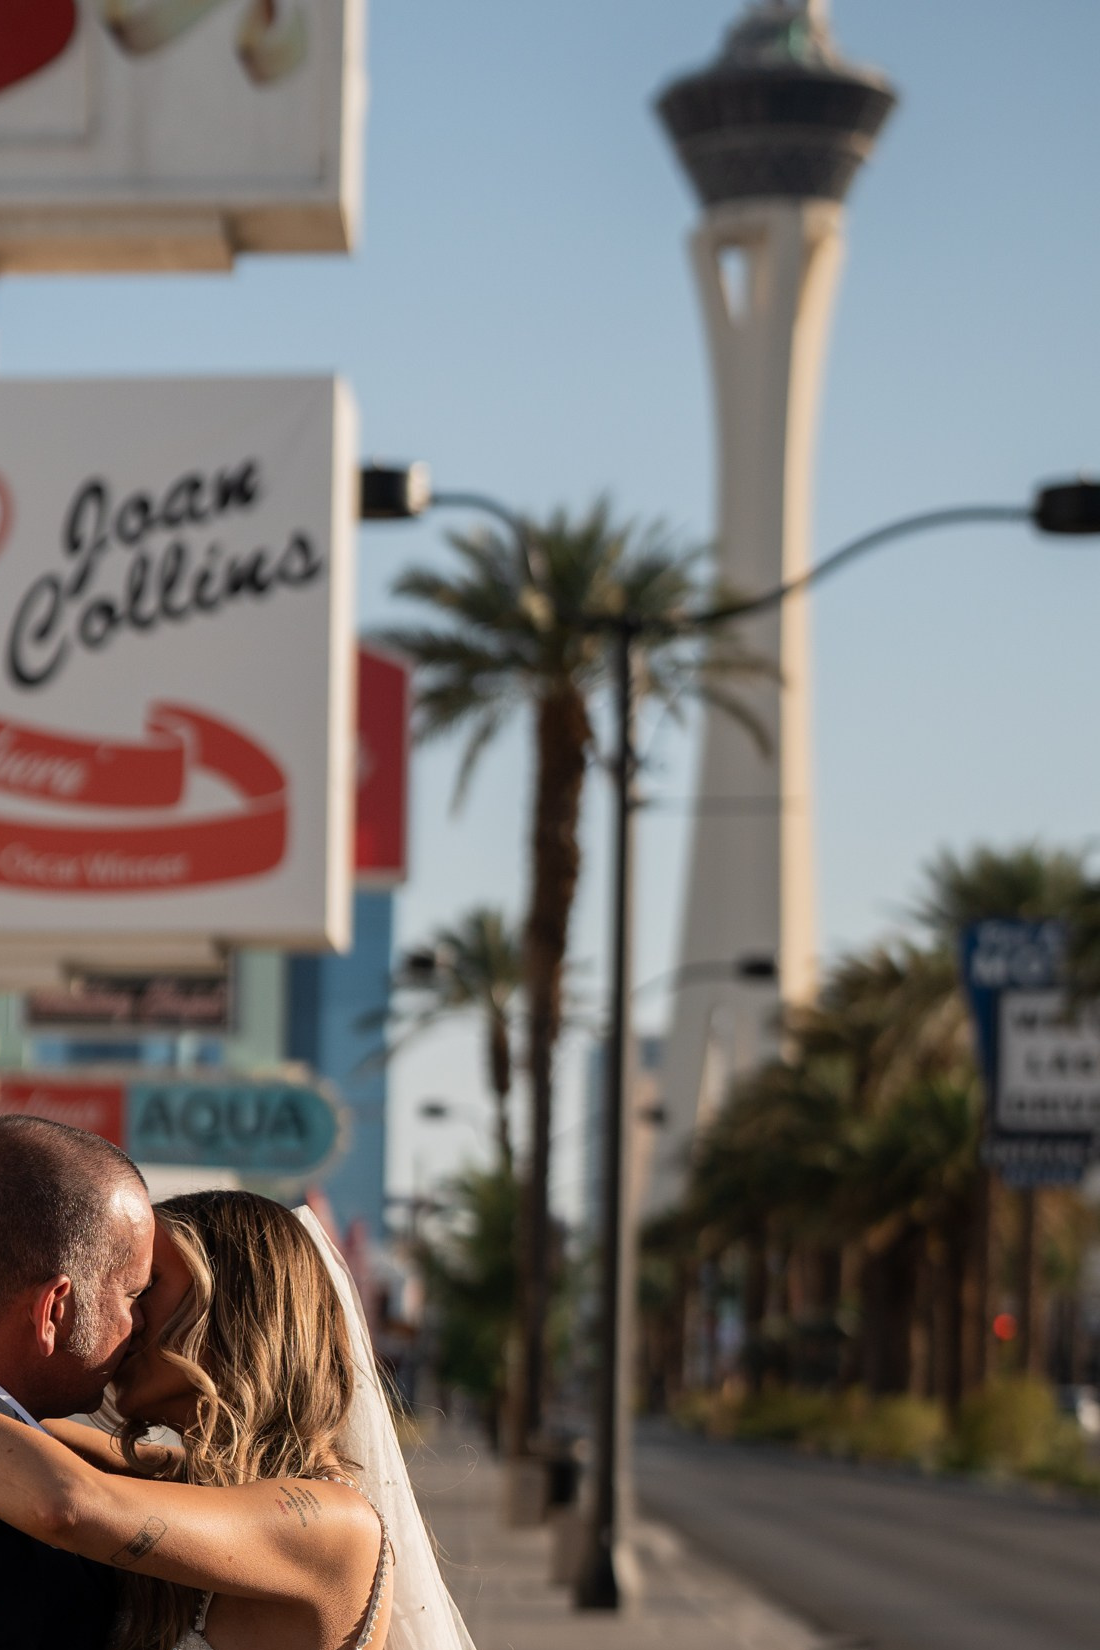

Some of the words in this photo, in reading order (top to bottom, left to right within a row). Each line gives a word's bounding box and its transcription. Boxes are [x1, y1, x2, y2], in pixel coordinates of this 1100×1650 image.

[62, 456, 259, 599] Joan
[5, 529, 322, 690] Collins
[0, 840, 80, 886] Oscar
[82, 853, 188, 888] Winner
[137, 1087, 311, 1151] AQUA
